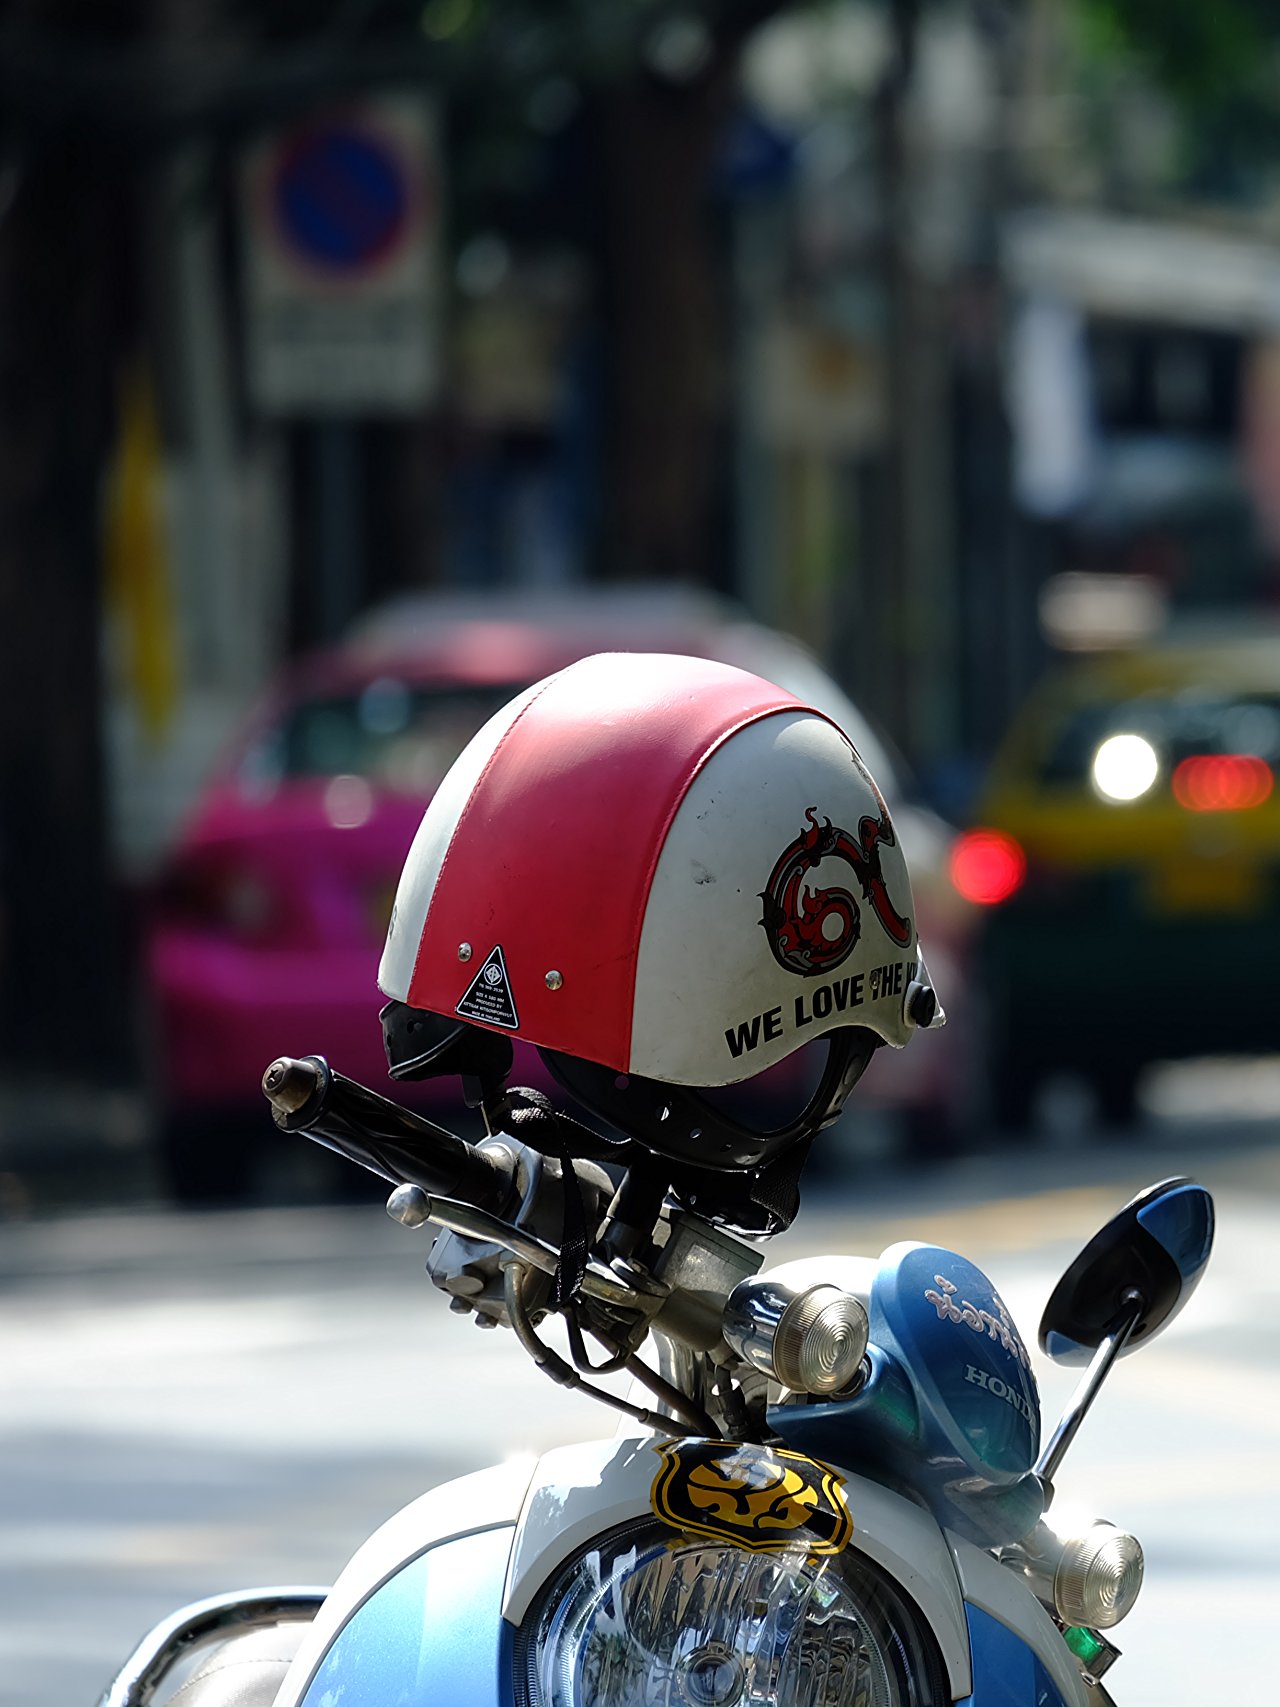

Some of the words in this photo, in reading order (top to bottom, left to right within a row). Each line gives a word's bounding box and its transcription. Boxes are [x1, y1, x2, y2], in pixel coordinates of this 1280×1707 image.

[725, 1006, 783, 1058] WE
[795, 973, 864, 1028] LOVE
[869, 962, 903, 1001] THE
[964, 1364, 1037, 1436] HONDA
